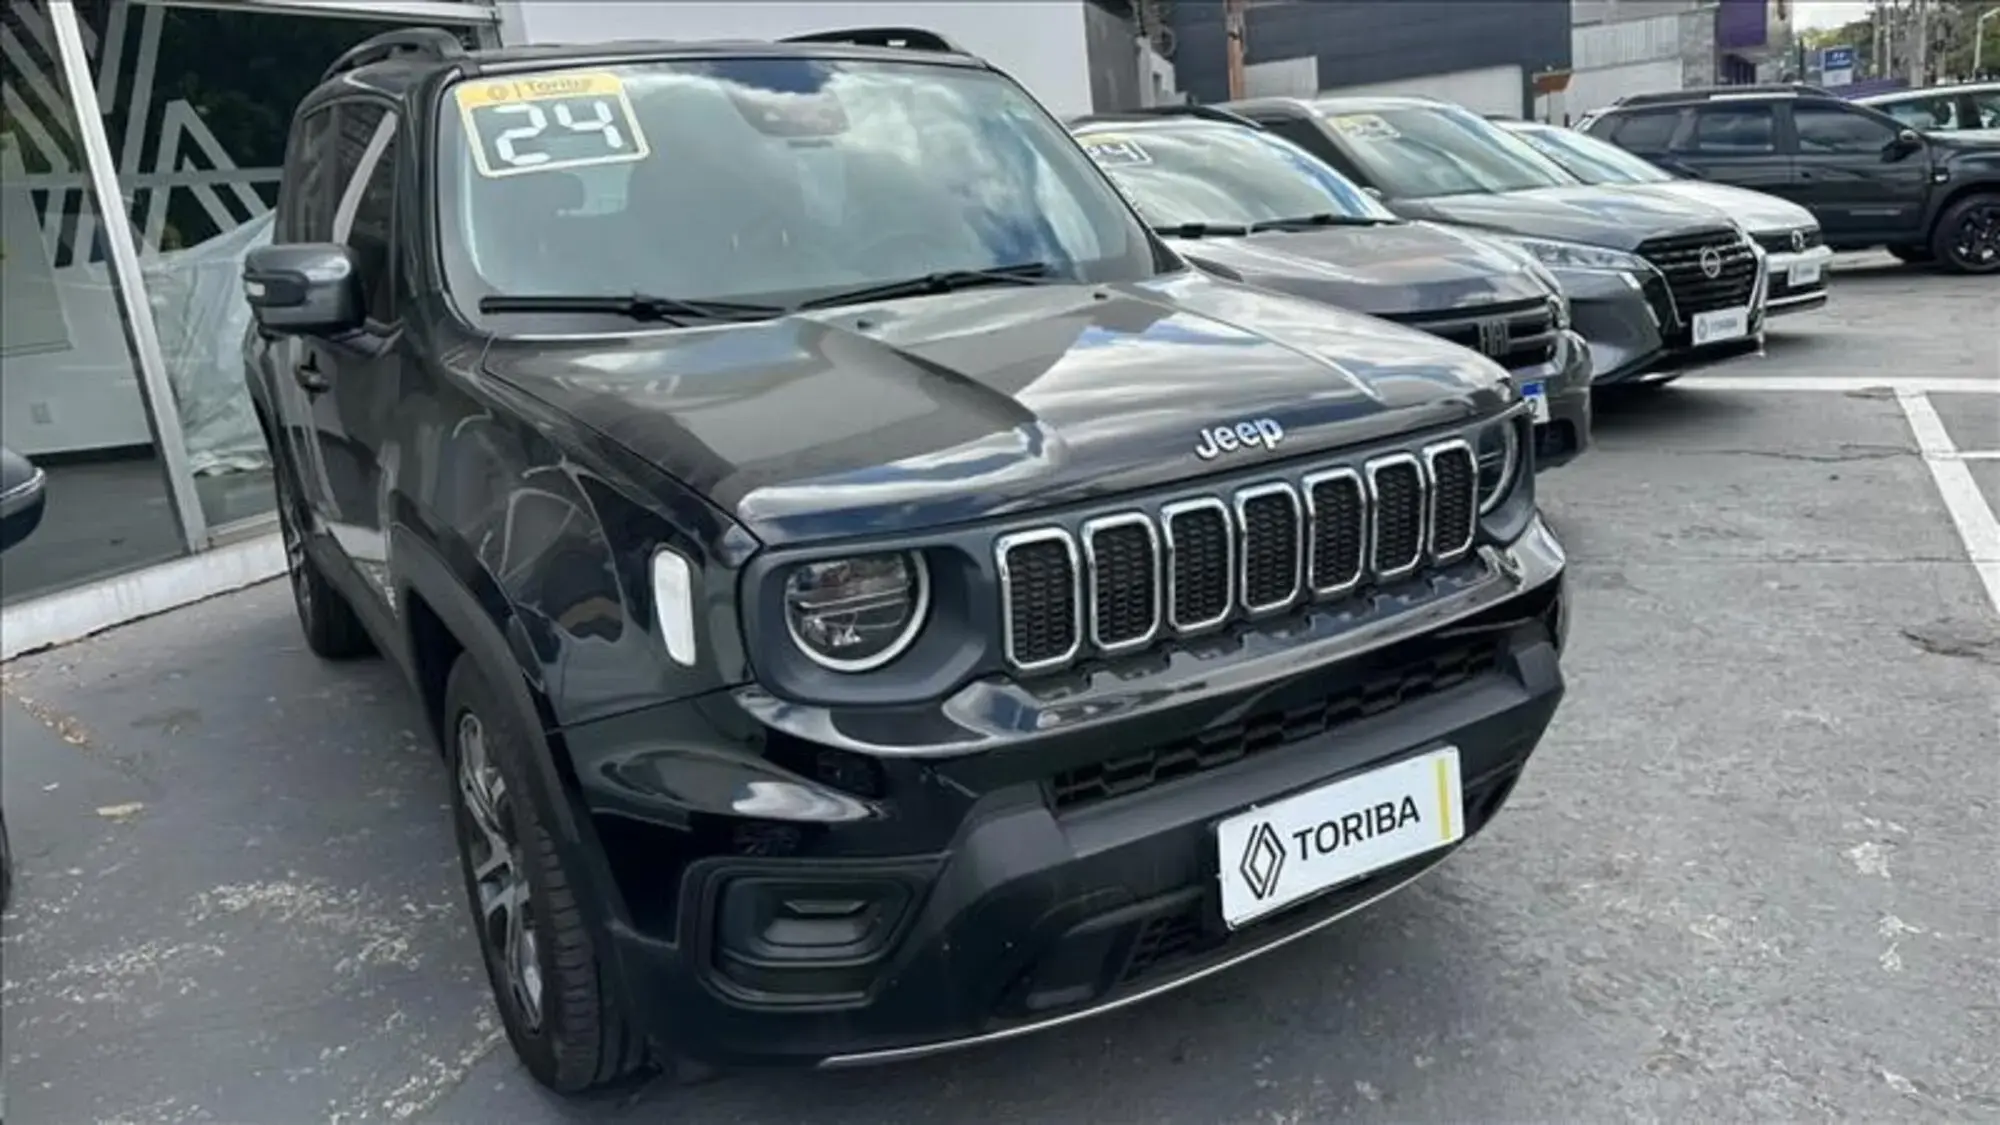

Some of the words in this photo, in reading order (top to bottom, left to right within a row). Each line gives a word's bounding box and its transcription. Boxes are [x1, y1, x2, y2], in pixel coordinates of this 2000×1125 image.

[493, 99, 624, 166] 24
[1194, 417, 1285, 459] Jeep
[1292, 794, 1421, 861] TORIBA
